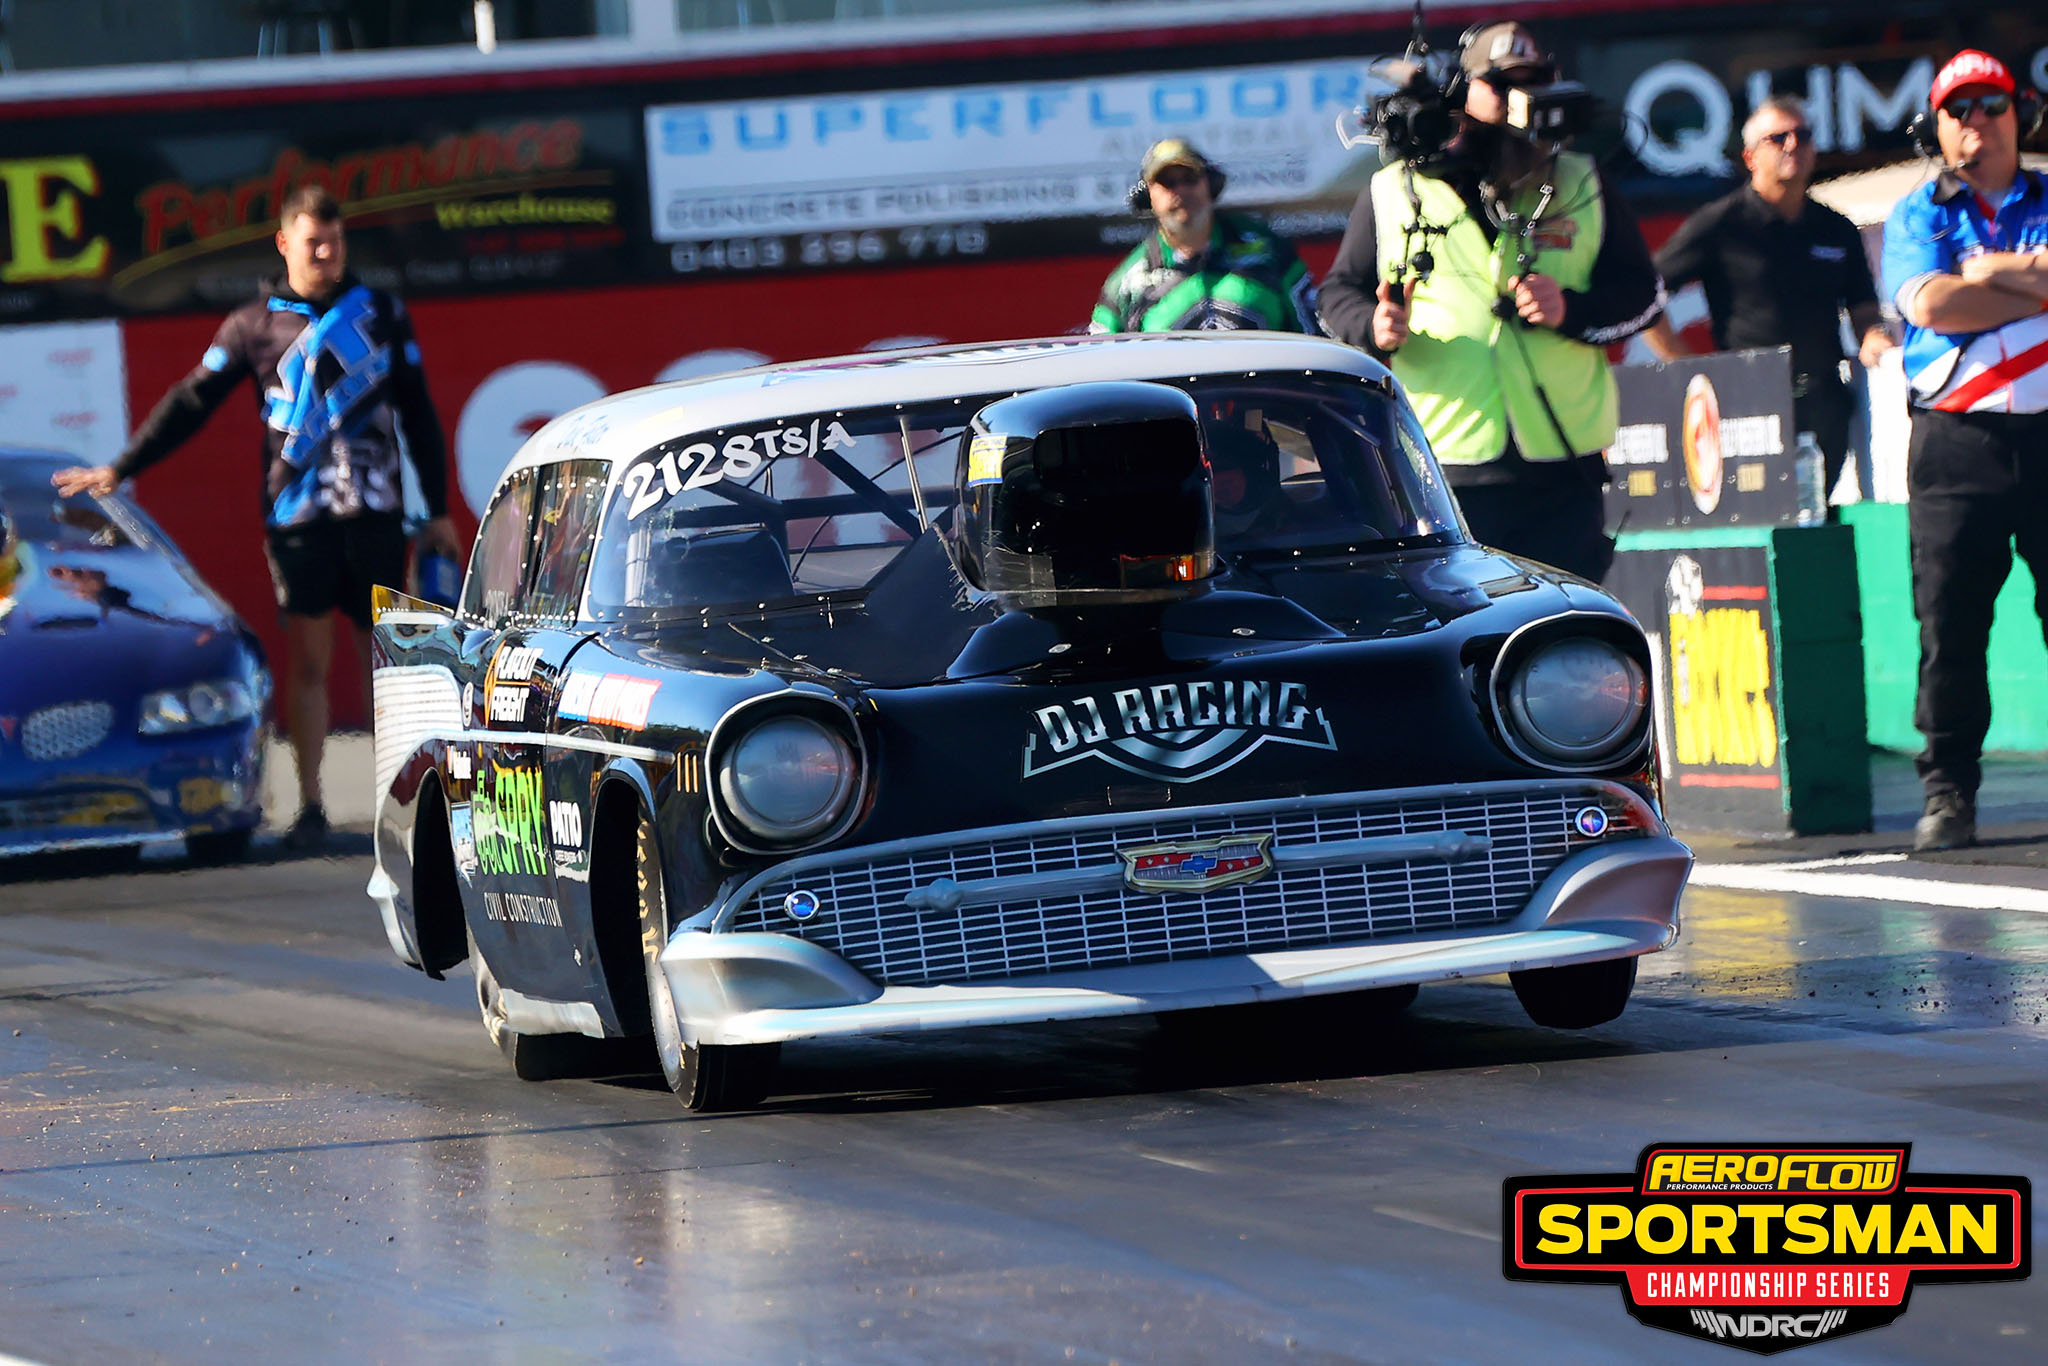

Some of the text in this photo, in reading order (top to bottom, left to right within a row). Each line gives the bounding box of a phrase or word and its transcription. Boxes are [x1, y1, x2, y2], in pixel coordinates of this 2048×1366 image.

[659, 66, 1364, 156] SUPERFLOOR
[671, 239, 785, 272] 0403
[898, 222, 987, 258] 770
[1036, 680, 1309, 753] DJ RACING
[549, 800, 582, 848] PATIO
[484, 892, 563, 927] CIVIL CONSTRUCTION
